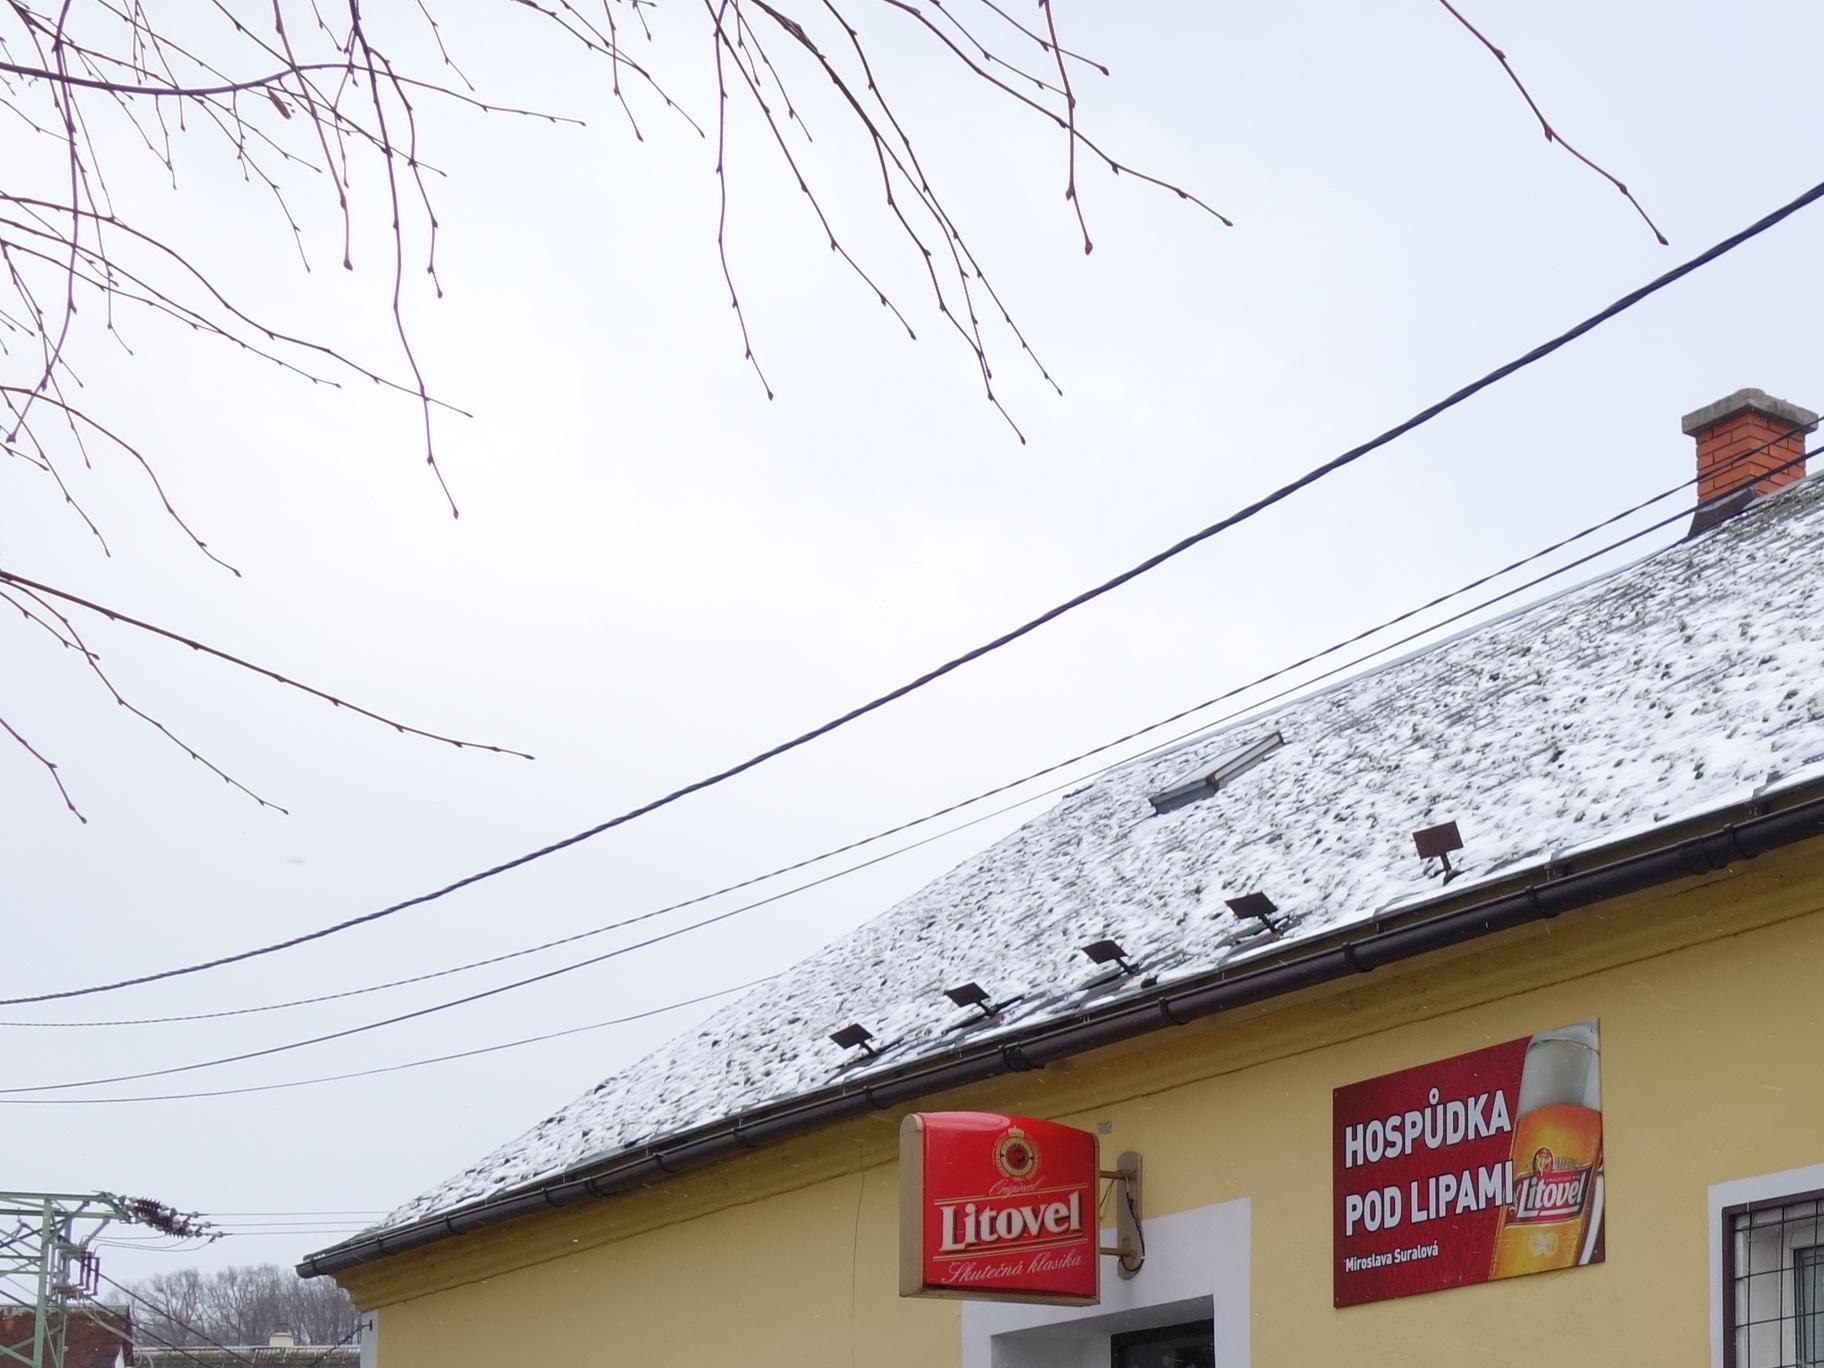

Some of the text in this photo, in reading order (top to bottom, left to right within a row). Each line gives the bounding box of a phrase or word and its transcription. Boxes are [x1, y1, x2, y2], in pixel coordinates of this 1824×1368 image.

[1345, 1088, 1512, 1168] HOSPŮDKA
[939, 1190, 1082, 1252] Litovel
[1345, 1160, 1513, 1236] POD LIPAMI
[1515, 1171, 1586, 1218] Litovel
[941, 1248, 1083, 1284] Skutečná klasika
[1345, 1240, 1439, 1273] Miroslava Suralová
